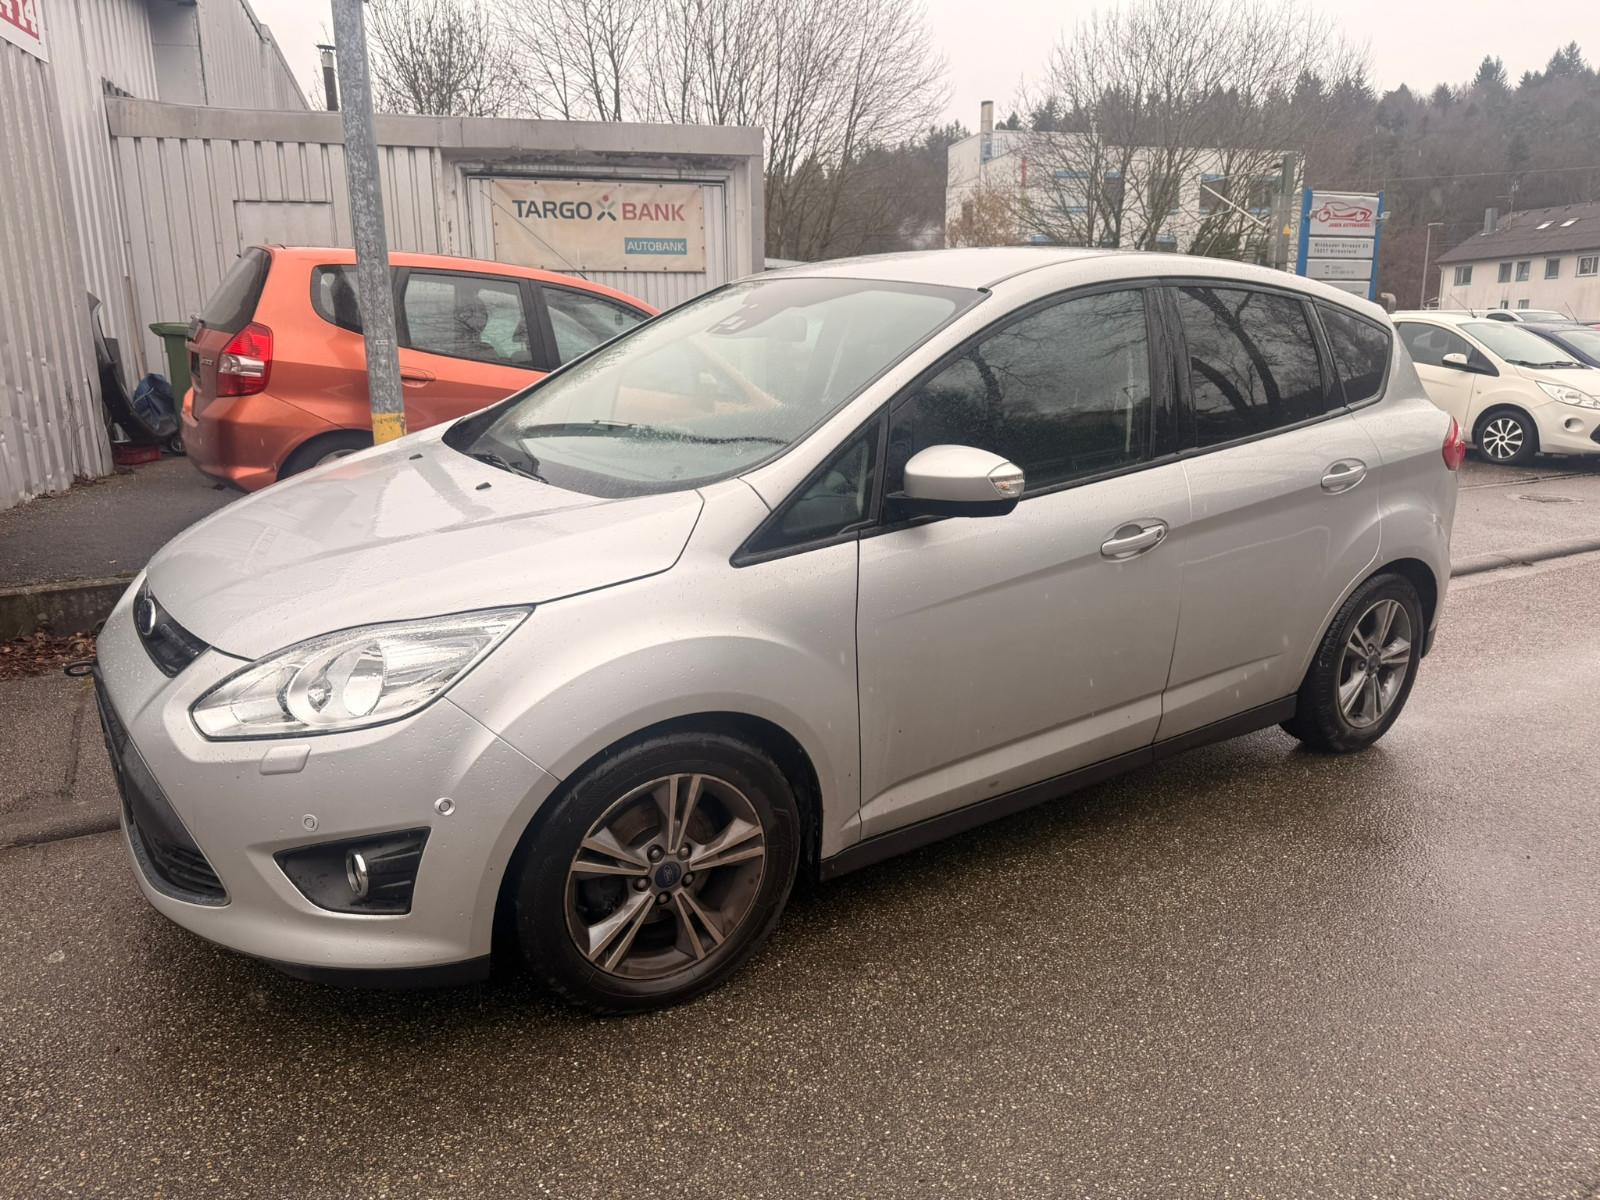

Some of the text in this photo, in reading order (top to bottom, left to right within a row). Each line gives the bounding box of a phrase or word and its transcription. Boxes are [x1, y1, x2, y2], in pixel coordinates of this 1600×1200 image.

[511, 199, 685, 222] TARGO BANK
[627, 240, 685, 252] AUTOBANK
